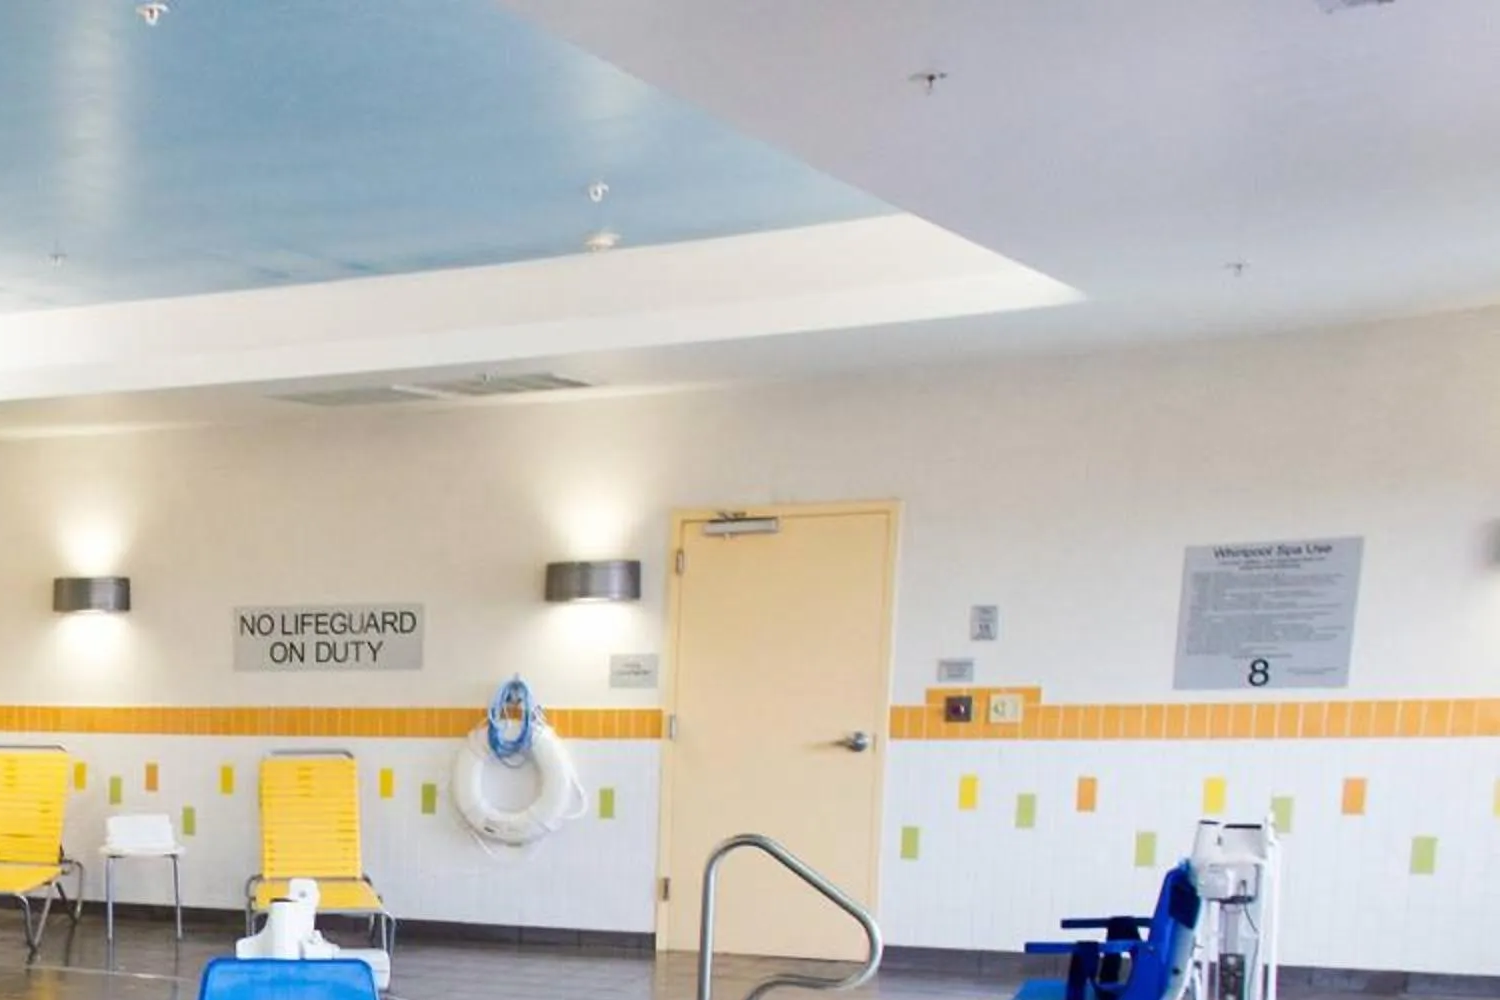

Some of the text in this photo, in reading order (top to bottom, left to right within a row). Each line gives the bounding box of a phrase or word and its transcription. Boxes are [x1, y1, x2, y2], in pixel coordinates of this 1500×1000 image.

[240, 612, 417, 636] NO LIFEGUARD
[269, 641, 383, 663] ON DUTY
[1248, 658, 1269, 687] 8
